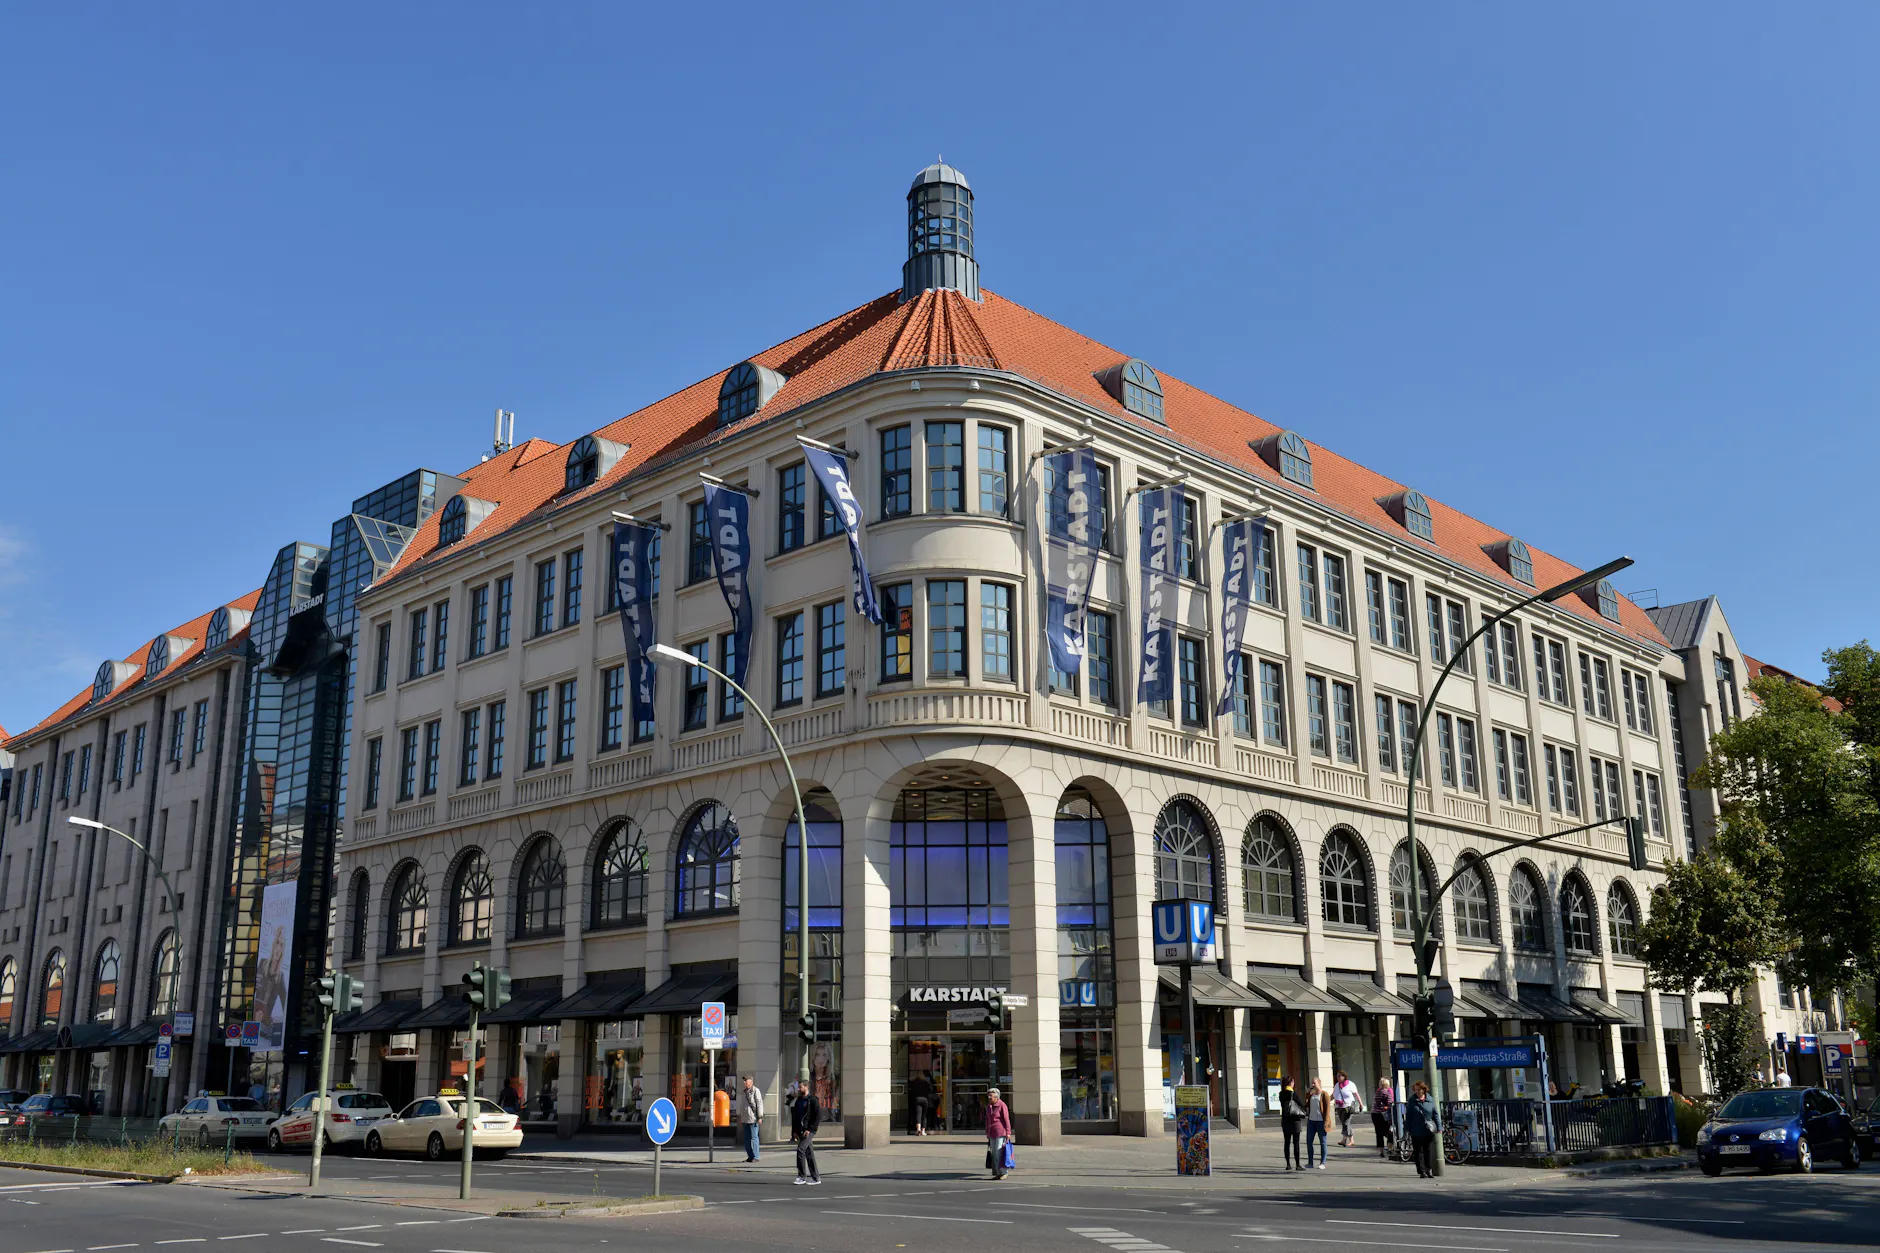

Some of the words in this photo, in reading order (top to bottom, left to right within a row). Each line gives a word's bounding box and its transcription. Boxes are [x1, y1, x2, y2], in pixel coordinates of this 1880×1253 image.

[1064, 470, 1089, 656] KARSTADT
[1143, 508, 1169, 683] KARSTADT
[1158, 905, 1182, 942] U
[1193, 905, 1211, 942] U
[1166, 948, 1177, 957] U6
[910, 987, 1007, 1002] KARSTADT
[705, 1027, 723, 1036] TAXI
[243, 1037, 258, 1045] TAXI
[159, 1045, 168, 1058] P
[1826, 1048, 1841, 1067] P
